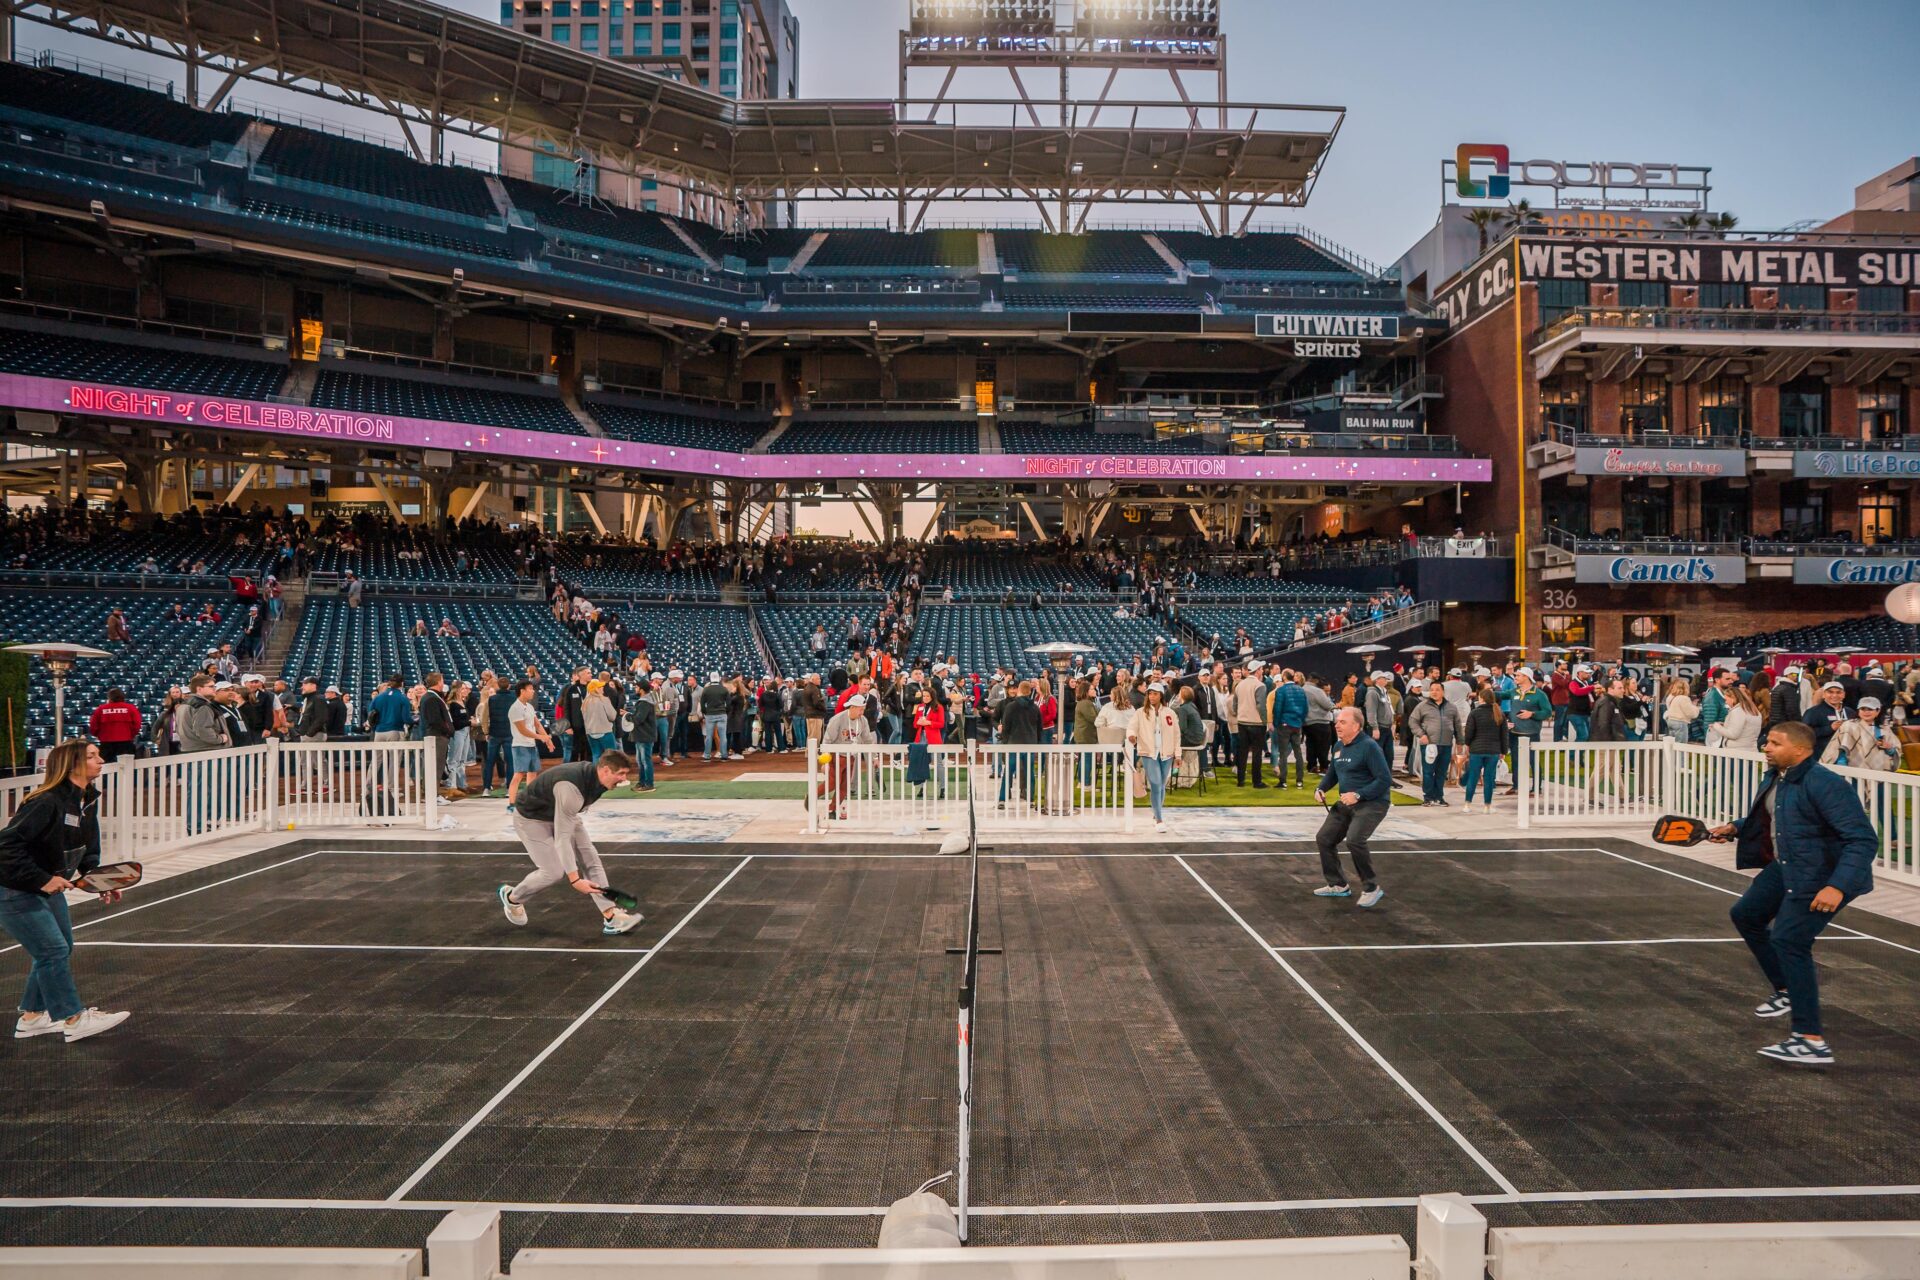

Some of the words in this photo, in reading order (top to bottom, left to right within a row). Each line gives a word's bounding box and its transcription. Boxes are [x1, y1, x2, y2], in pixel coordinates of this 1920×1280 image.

[1521, 159, 1702, 189] QUIDEL
[1520, 244, 1700, 281] WESTERN
[1721, 250, 1847, 284] METAL
[1478, 257, 1515, 307] CO.
[1272, 315, 1384, 337] CUTWATER
[1294, 341, 1361, 358] SPIRITS
[71, 386, 171, 416] NIGHT
[176, 401, 195, 416] of
[202, 401, 393, 439] CELEBRATION
[1346, 417, 1369, 428] BALI
[1372, 418, 1389, 428] HAI
[1392, 418, 1414, 429] RUM
[1026, 458, 1082, 474] NIGHT
[1085, 460, 1097, 473] of
[1101, 458, 1226, 475] CELEBRATION
[1666, 461, 1689, 473] San
[1690, 461, 1723, 475] Diego
[1456, 540, 1474, 549] EXIT
[1609, 556, 1716, 581] Canel's
[1543, 589, 1577, 609] 336
[1165, 715, 1173, 726] C
